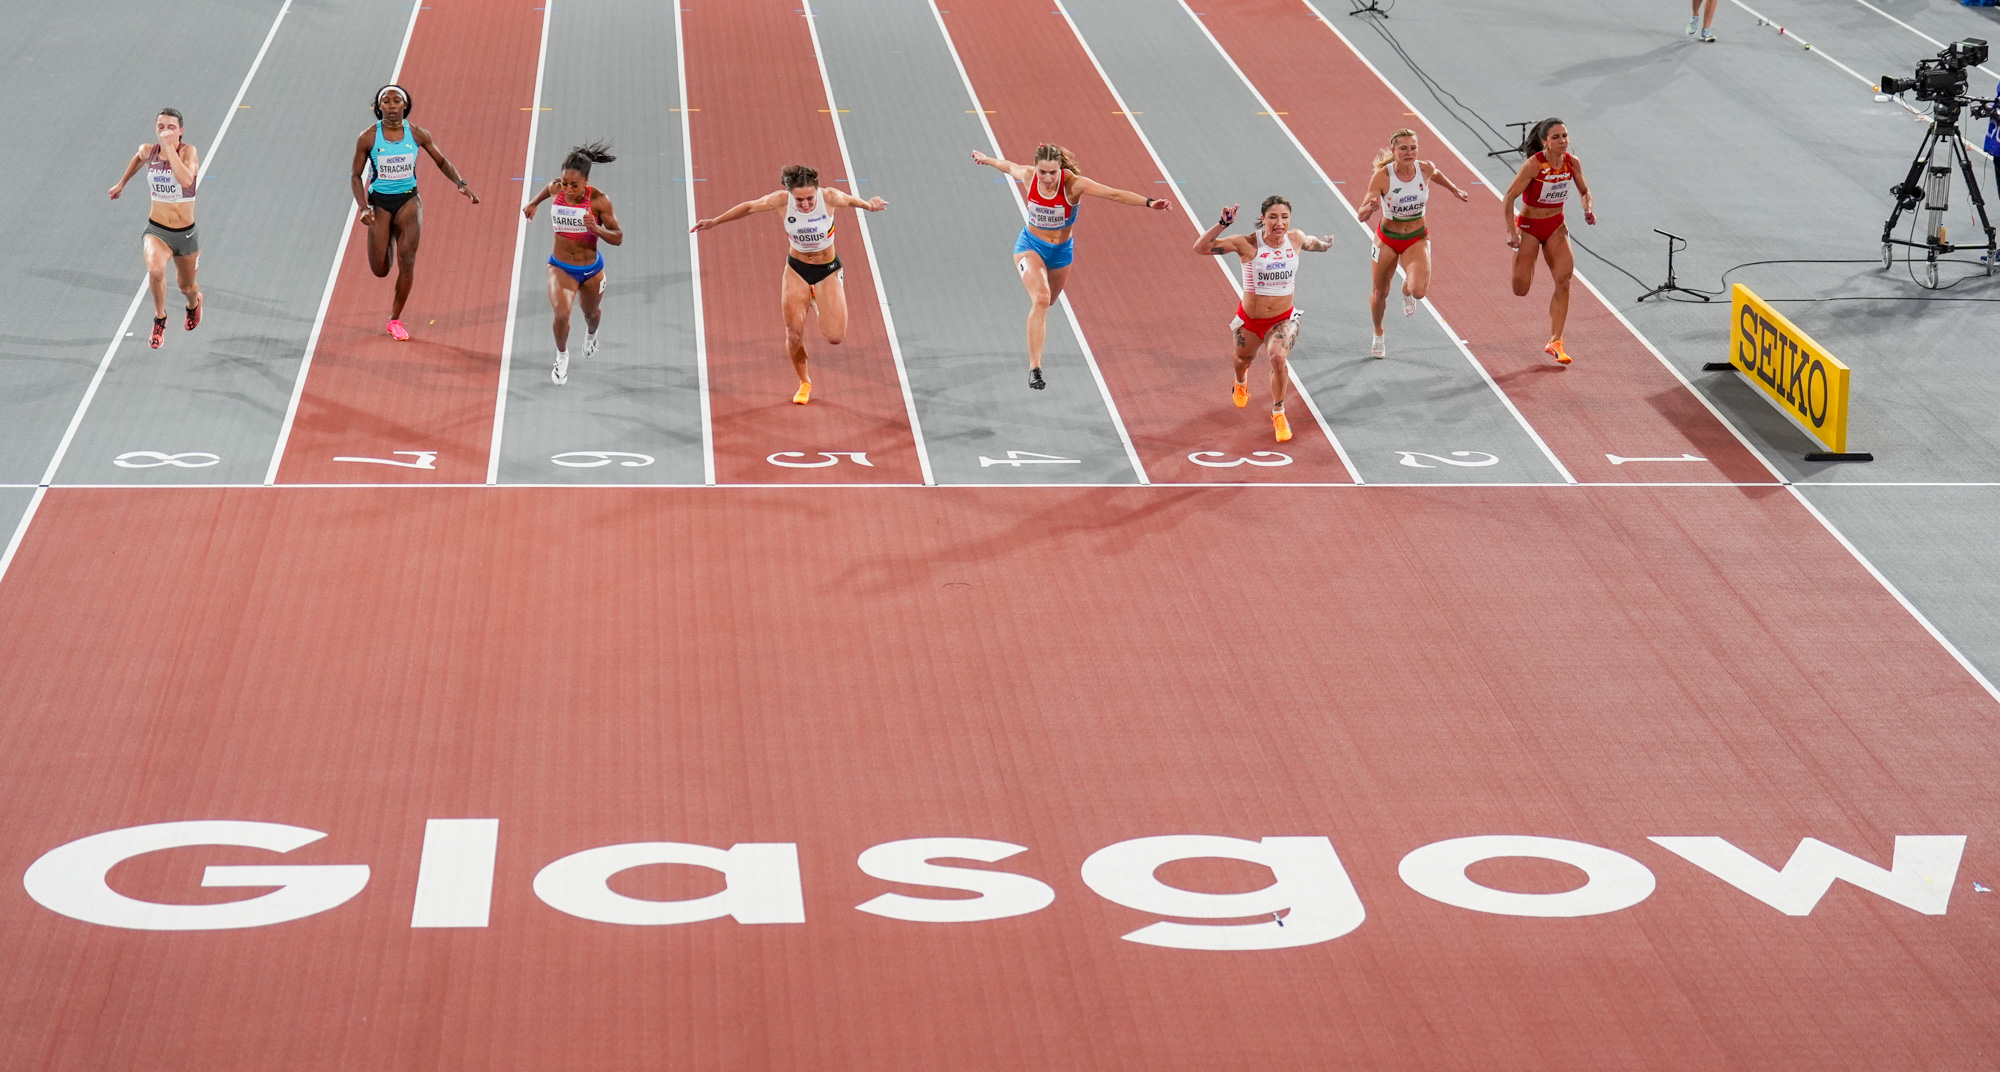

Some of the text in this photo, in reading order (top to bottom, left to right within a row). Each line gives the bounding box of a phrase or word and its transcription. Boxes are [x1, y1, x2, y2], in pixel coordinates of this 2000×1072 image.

[379, 163, 412, 173] STRACHAN
[152, 184, 176, 193] LEDUC
[1545, 190, 1568, 199] PÉREZ
[552, 215, 583, 227] BARNES
[1038, 214, 1047, 222] DER
[793, 232, 825, 242] ROSIUS
[1258, 270, 1293, 280] SWOBODA
[1739, 303, 1828, 429] SEIKO
[113, 451, 221, 468] 8
[333, 451, 437, 469] 7
[551, 451, 656, 467] 6
[766, 452, 874, 467] 5
[979, 451, 1081, 468] 4
[1187, 451, 1293, 467] 3
[1394, 451, 1500, 468] 2
[1604, 453, 1708, 465] 1
[23, 818, 1968, 951] Glasgow
